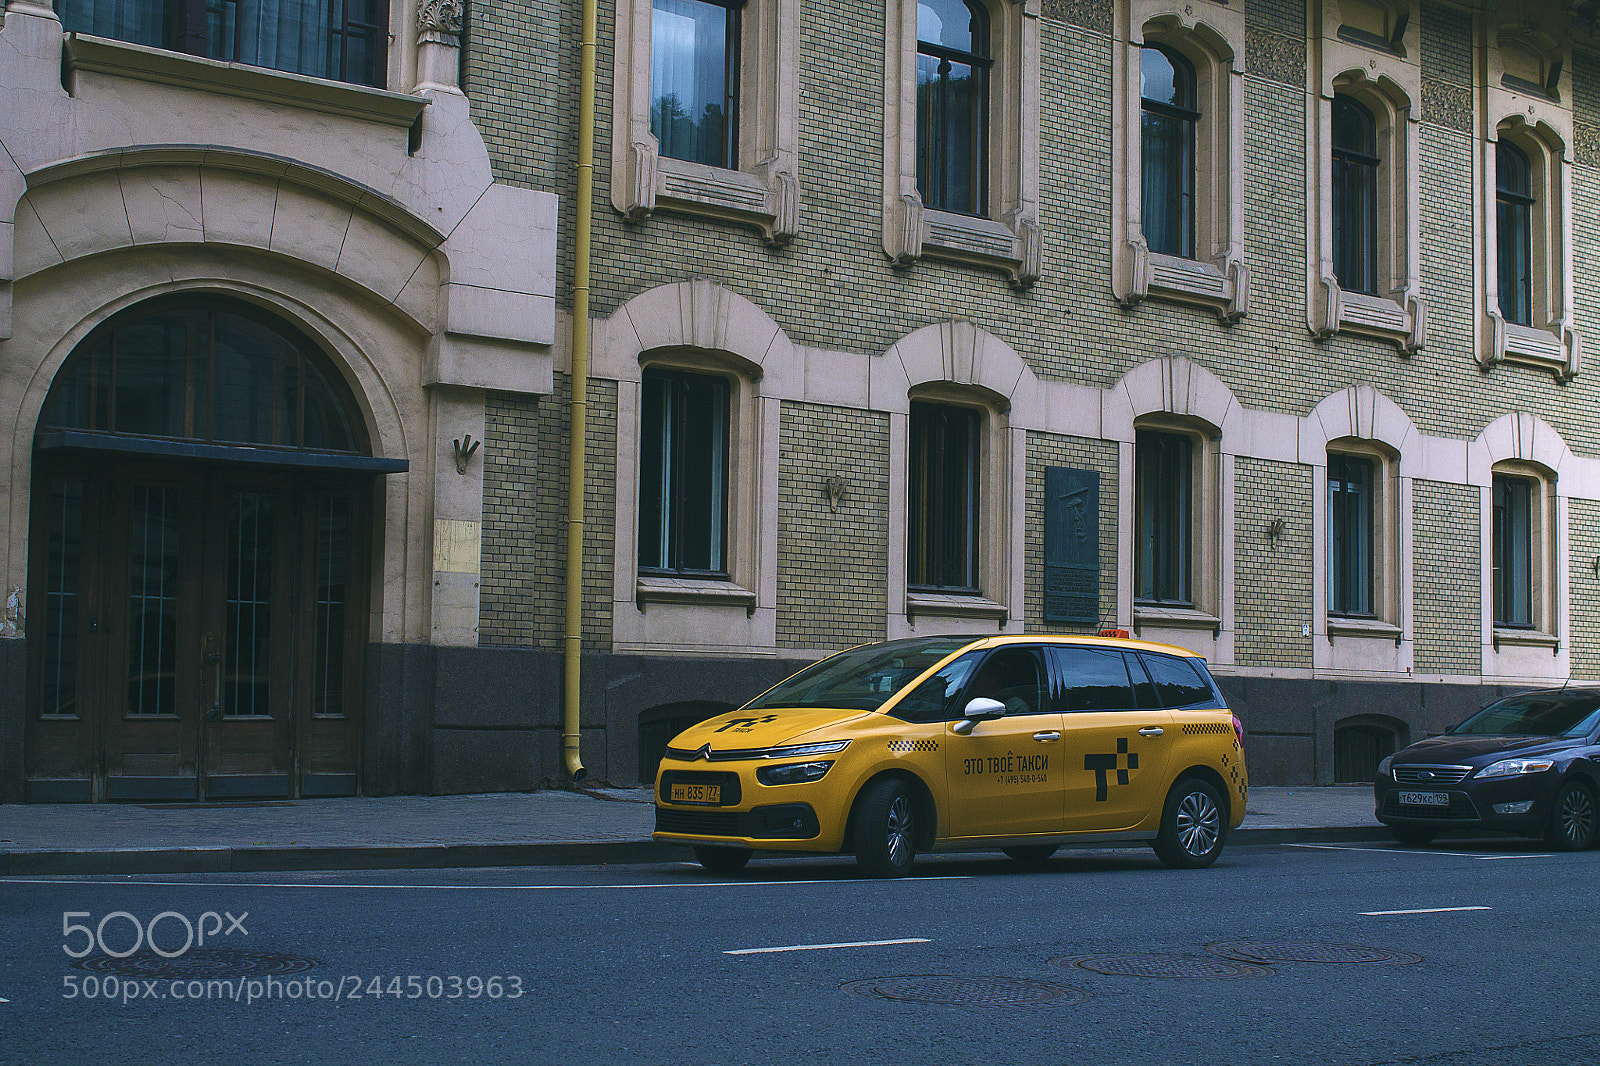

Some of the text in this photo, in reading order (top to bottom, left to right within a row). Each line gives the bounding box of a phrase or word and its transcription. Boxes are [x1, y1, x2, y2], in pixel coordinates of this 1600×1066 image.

[964, 758, 984, 775] ЭТО
[1016, 754, 1049, 772] ТАКСИ
[997, 776, 1004, 785] +7
[1005, 775, 1019, 786] (495)
[687, 786, 704, 800] 835
[709, 786, 718, 797] 77
[1434, 793, 1447, 801] 199
